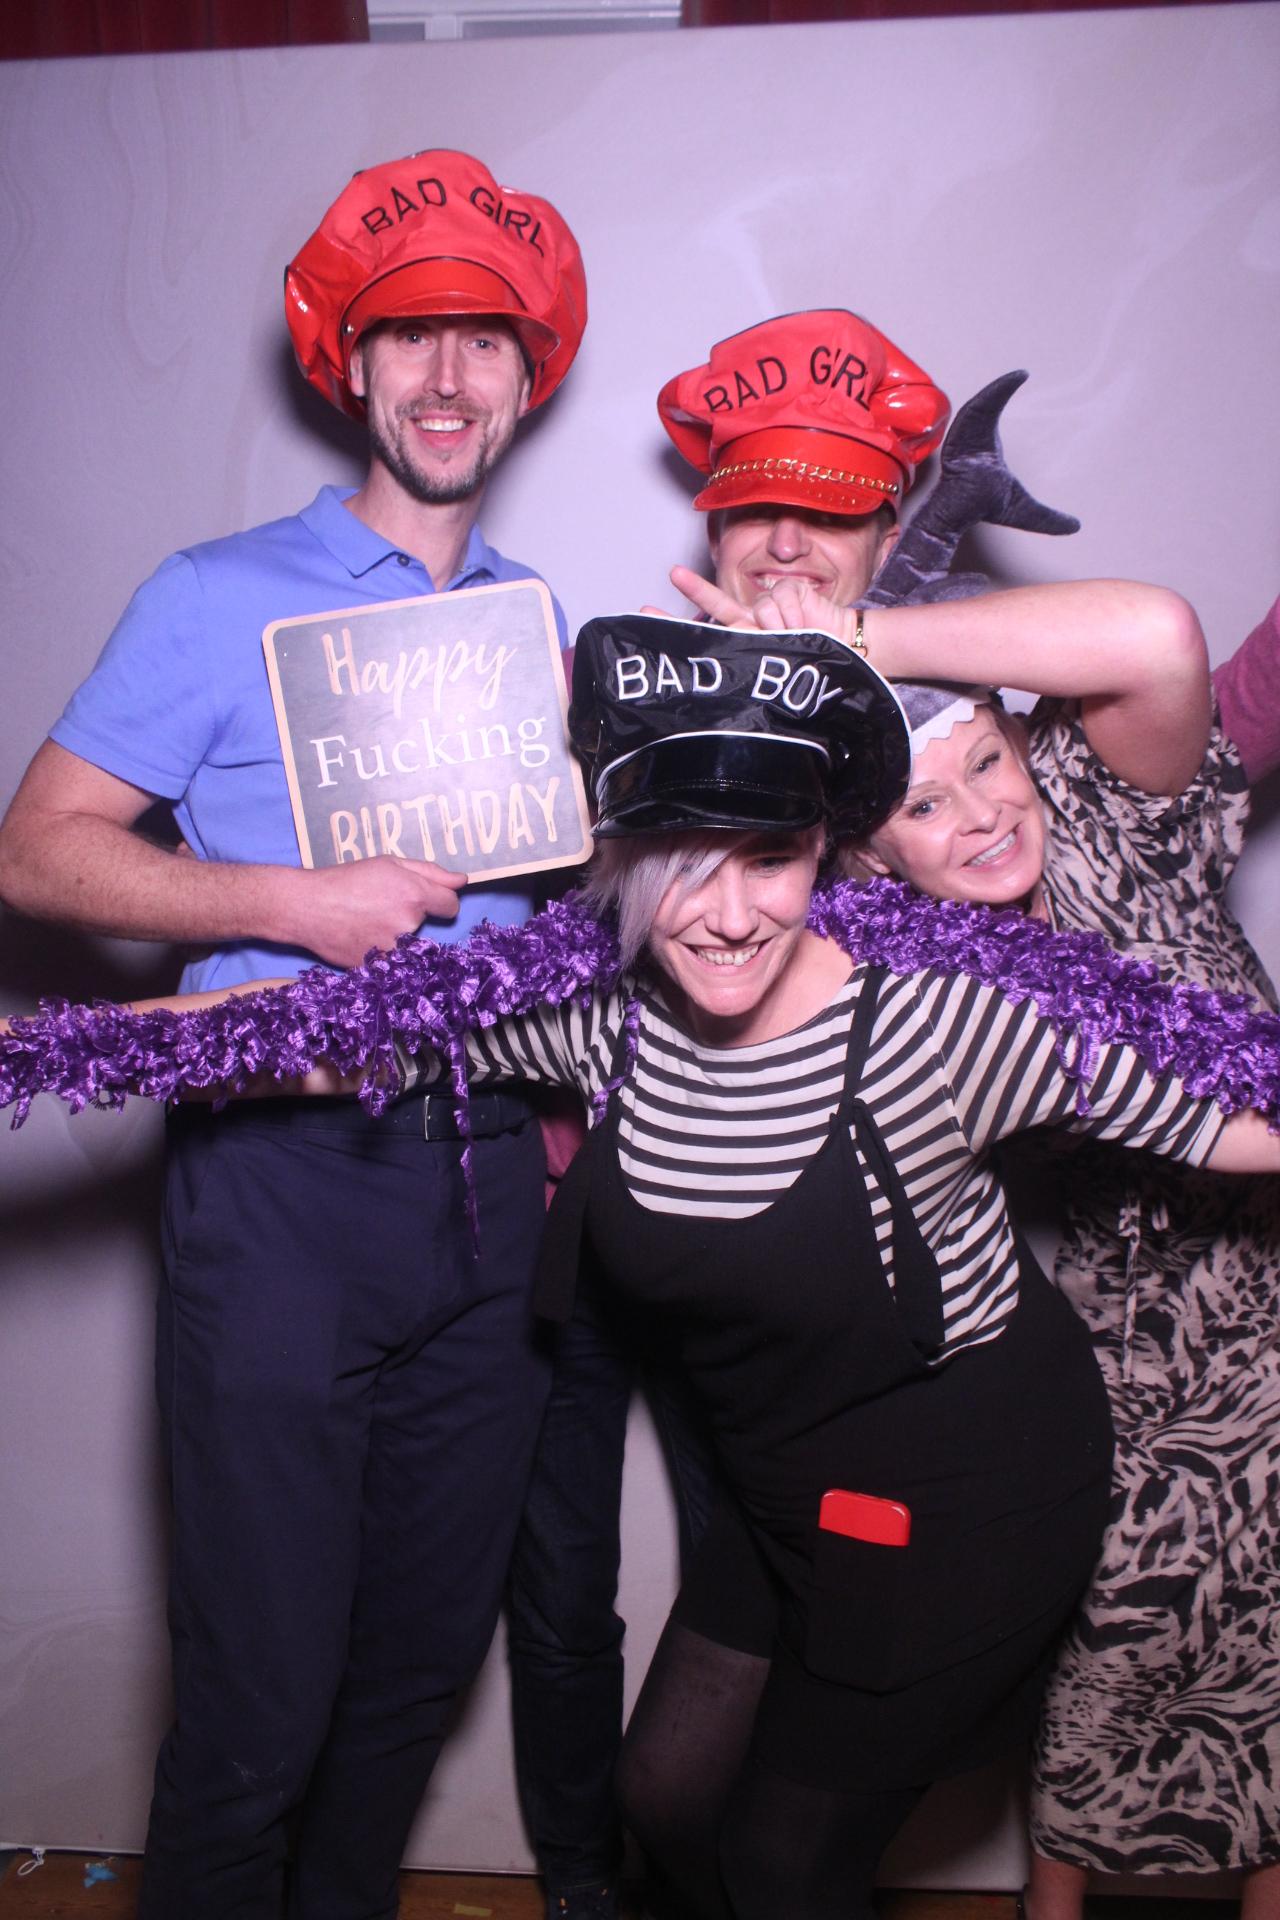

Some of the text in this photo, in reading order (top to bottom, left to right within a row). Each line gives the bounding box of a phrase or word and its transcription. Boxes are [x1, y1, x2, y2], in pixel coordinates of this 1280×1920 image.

[361, 178, 545, 257] BAD GIRL
[703, 356, 788, 413] BAD
[321, 628, 518, 719] Happy
[616, 653, 843, 718] BAD BOY
[309, 712, 551, 788] Fucking
[330, 777, 561, 865] BIRTHDAY
